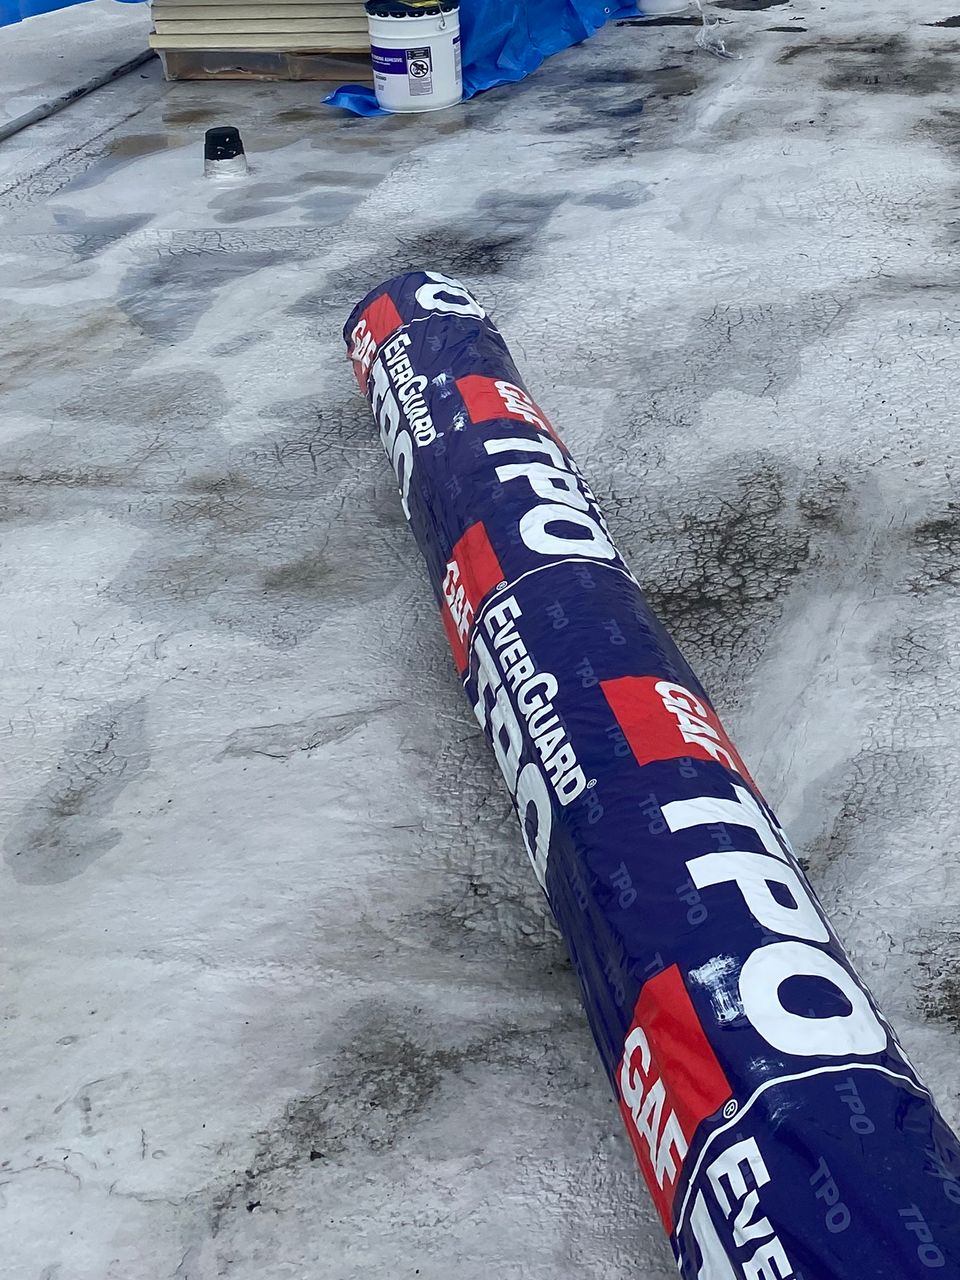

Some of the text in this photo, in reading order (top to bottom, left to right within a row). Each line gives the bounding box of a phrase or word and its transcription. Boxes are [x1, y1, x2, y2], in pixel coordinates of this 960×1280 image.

[384, 333, 436, 448] EVERGUARD
[484, 434, 616, 560] TPO
[442, 560, 474, 644] GAF
[545, 599, 569, 630] TPO
[602, 618, 626, 646] TPO
[484, 595, 587, 806] EVERGUARD
[576, 656, 599, 688] TPO
[654, 680, 737, 772] GAF
[474, 633, 552, 898] TPO
[638, 793, 667, 835] TPO
[609, 861, 638, 910] TPO
[660, 782, 887, 1057] TPO
[676, 879, 708, 926] TPO
[620, 1026, 689, 1191] GAF
[834, 1077, 875, 1134] TPO
[808, 1156, 851, 1234] TPO
[898, 1202, 945, 1268] TPO
